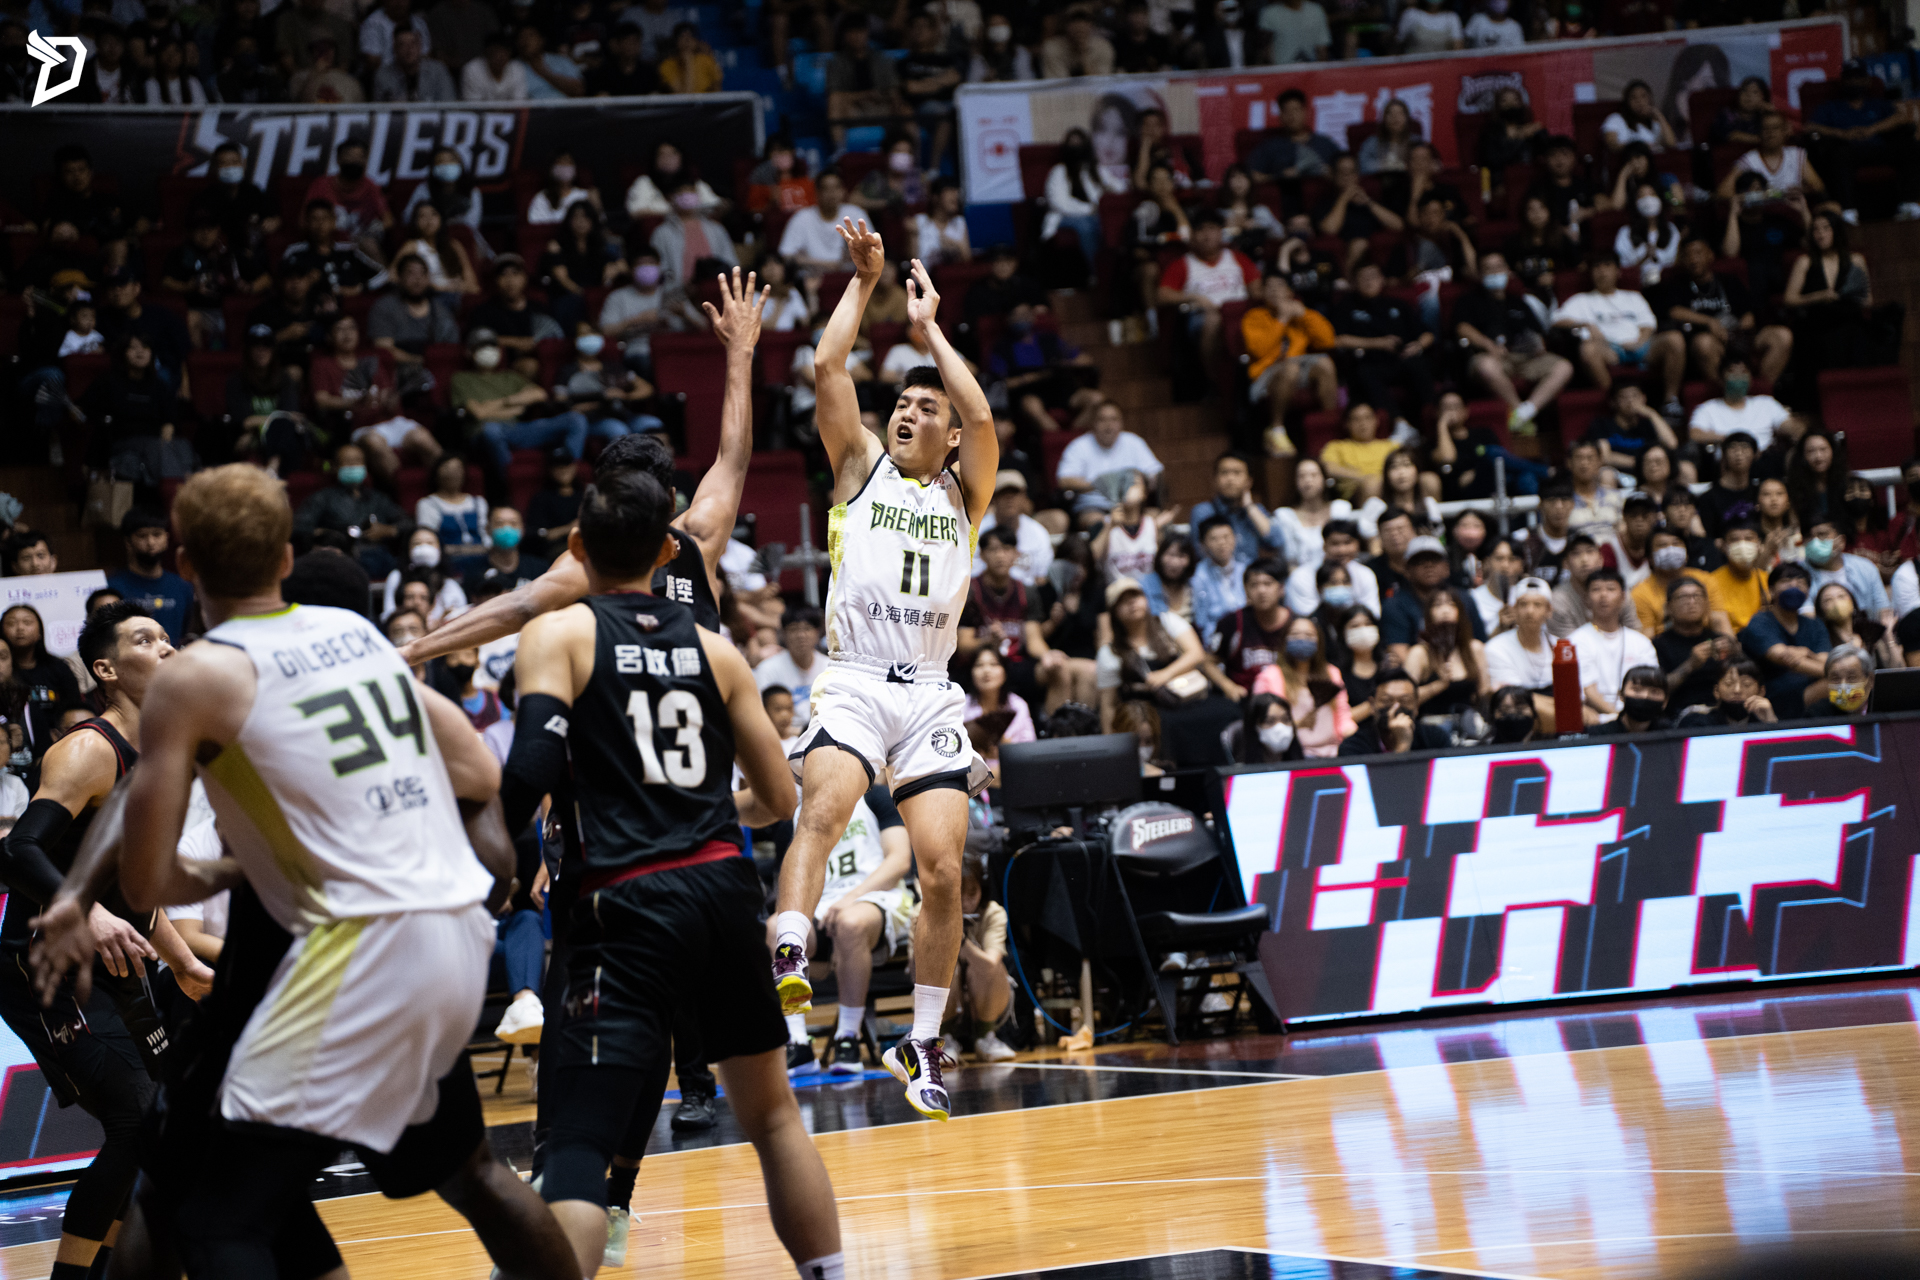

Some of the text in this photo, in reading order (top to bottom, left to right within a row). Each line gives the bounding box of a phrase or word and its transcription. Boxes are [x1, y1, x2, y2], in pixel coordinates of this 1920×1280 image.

[870, 500, 958, 547] DREAMERS
[900, 549, 930, 597] 11
[885, 604, 949, 630] 海碩集團
[273, 627, 381, 678] GILBECK
[291, 673, 427, 778] 34
[626, 689, 707, 788] 13
[1132, 817, 1193, 850] STEELERS
